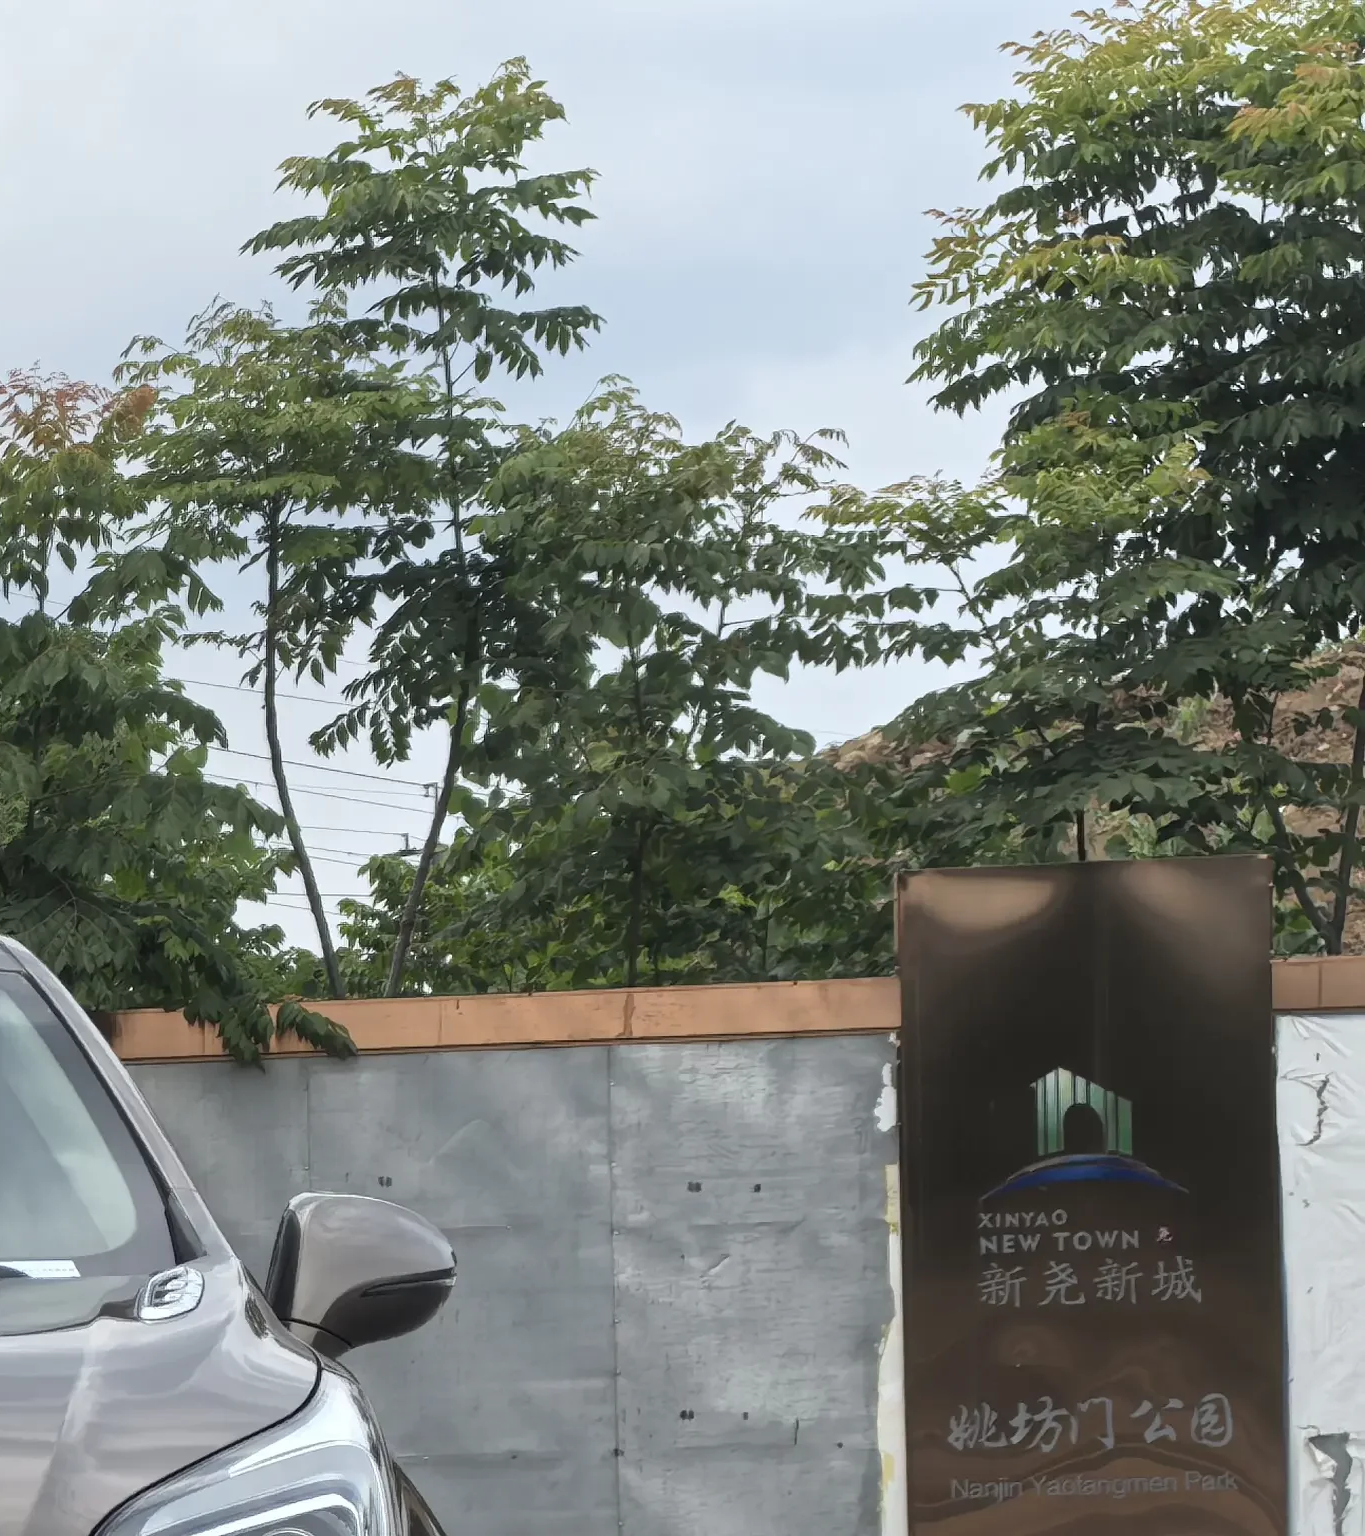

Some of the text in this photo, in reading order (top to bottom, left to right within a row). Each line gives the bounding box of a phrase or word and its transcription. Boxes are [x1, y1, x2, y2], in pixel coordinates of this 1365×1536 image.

[978, 1209, 1067, 1228] XINYAO
[980, 1230, 1139, 1254] NEW TOWN
[978, 1256, 1201, 1307] 新尧新城
[948, 1393, 1232, 1452] 姚坊门公园
[952, 1471, 1237, 1501] Nanjin Yaofangmen Park
